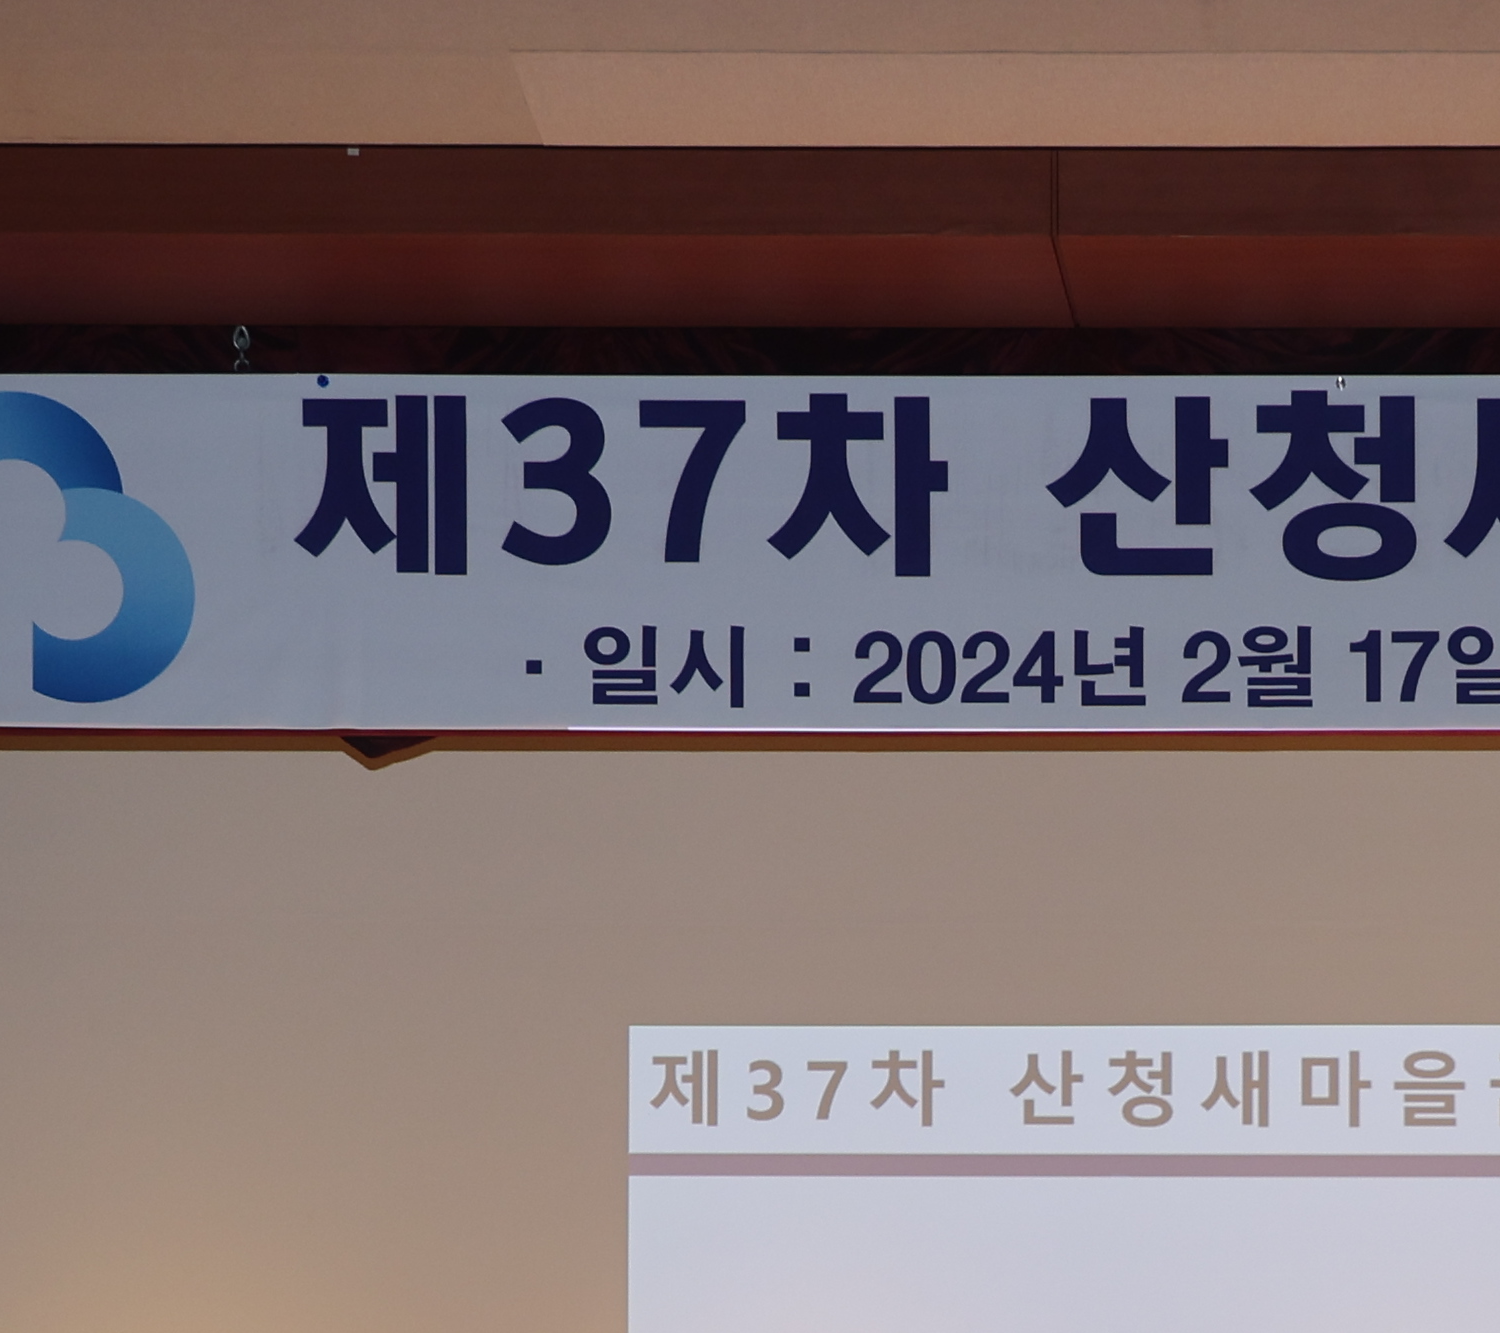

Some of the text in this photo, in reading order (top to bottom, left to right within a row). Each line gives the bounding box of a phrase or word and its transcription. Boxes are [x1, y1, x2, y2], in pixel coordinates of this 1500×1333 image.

[294, 390, 949, 578] 제37차
[584, 625, 745, 709] 일시
[853, 626, 1147, 707] 2024년
[1182, 626, 1314, 708] 2월
[650, 1048, 946, 1127] 제37차
